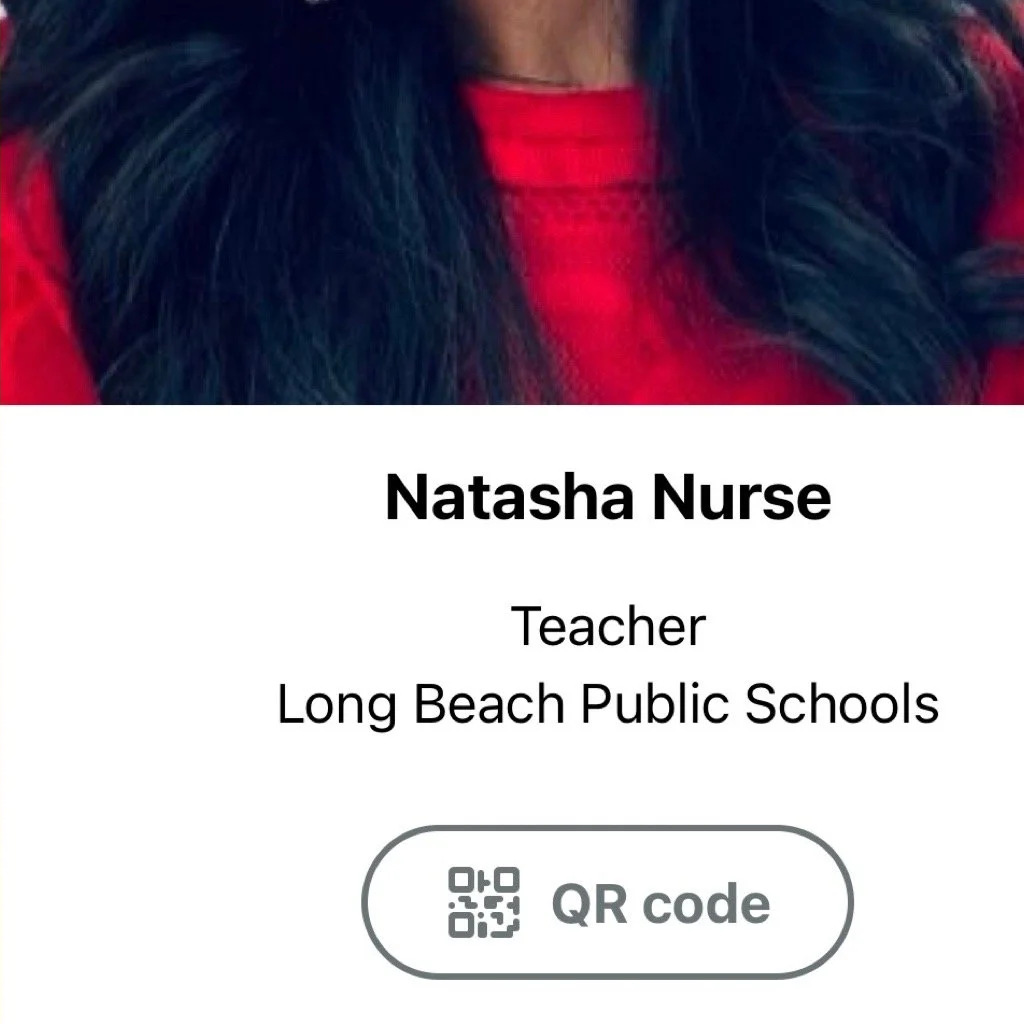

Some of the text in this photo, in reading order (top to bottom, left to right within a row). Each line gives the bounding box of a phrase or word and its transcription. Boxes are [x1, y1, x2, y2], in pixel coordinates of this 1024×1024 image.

[386, 472, 832, 521] Natasha Nurse
[511, 604, 707, 647] Teacher
[278, 682, 940, 733] Long Beach Public Schools
[552, 882, 771, 928] QR code
